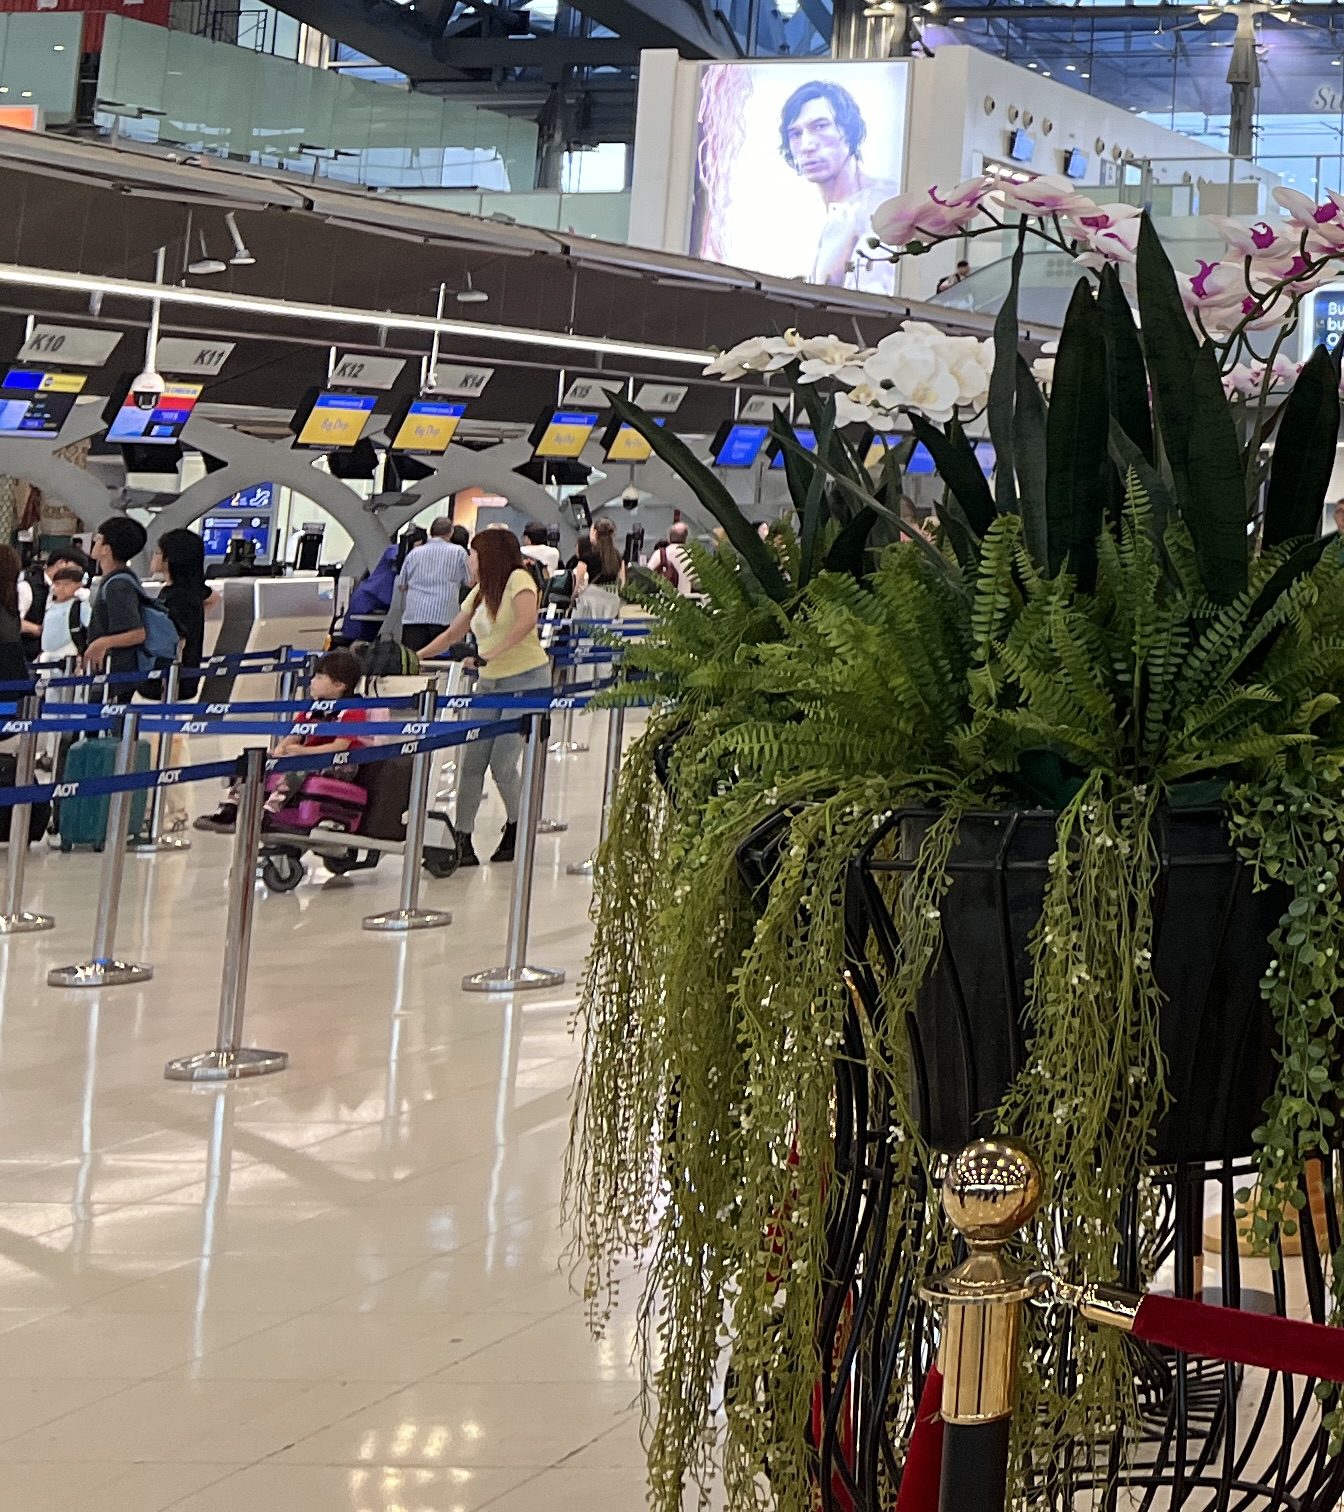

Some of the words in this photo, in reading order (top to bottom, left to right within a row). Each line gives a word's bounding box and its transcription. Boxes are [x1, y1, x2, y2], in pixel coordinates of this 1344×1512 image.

[30, 334, 66, 352] K10
[193, 349, 226, 366] K11
[337, 362, 365, 378] K12
[459, 373, 485, 388] K14
[310, 701, 336, 712] AOT
[447, 698, 472, 708] AOT
[550, 698, 575, 708] AOT
[101, 704, 127, 715] AOT
[205, 704, 231, 715] AOT
[2, 721, 33, 732] AOT
[180, 721, 208, 733] AOT
[290, 723, 318, 735] AOT
[402, 723, 430, 735] AOT
[401, 741, 418, 755] AOT
[332, 752, 350, 765] AOT
[157, 770, 182, 784] AOT
[52, 783, 79, 798] AOT
